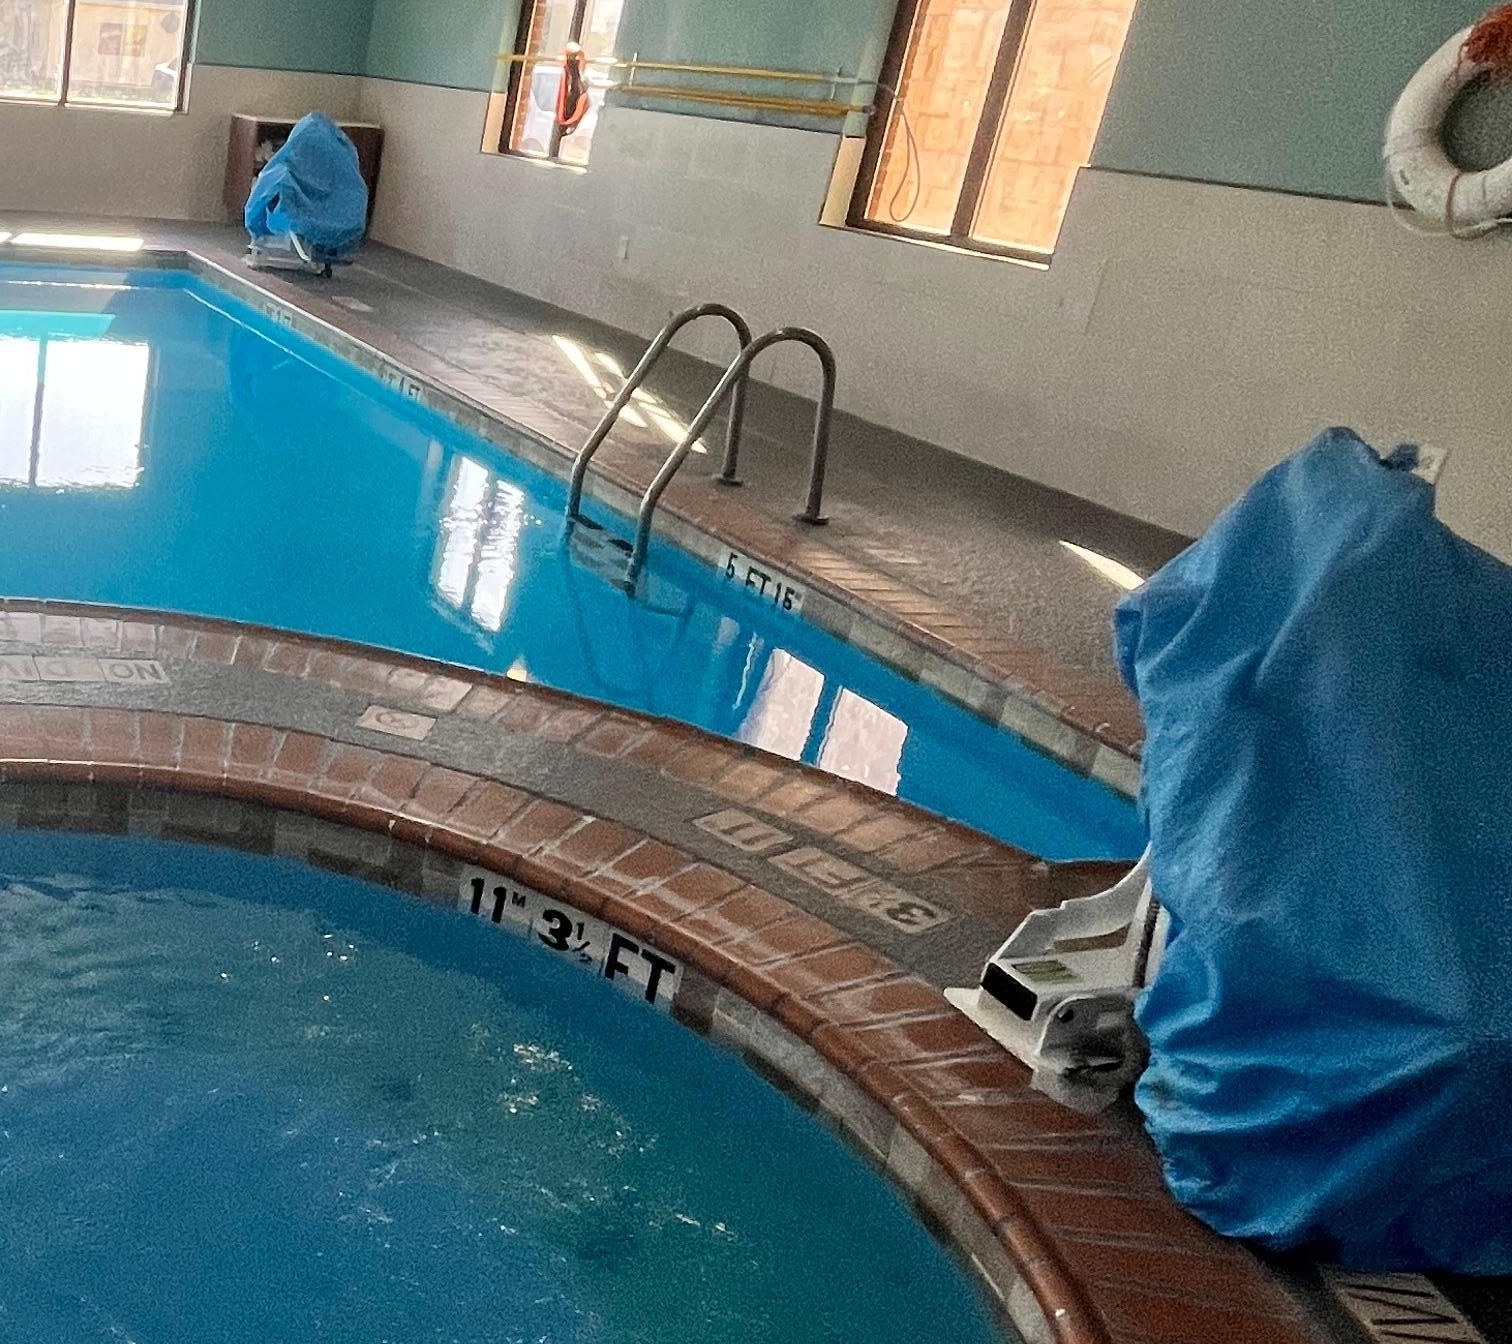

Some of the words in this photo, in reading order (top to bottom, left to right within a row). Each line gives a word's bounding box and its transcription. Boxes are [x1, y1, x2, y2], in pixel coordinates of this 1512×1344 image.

[745, 566, 772, 595] FT
[108, 661, 162, 681] NO
[604, 933, 676, 1004] FT
